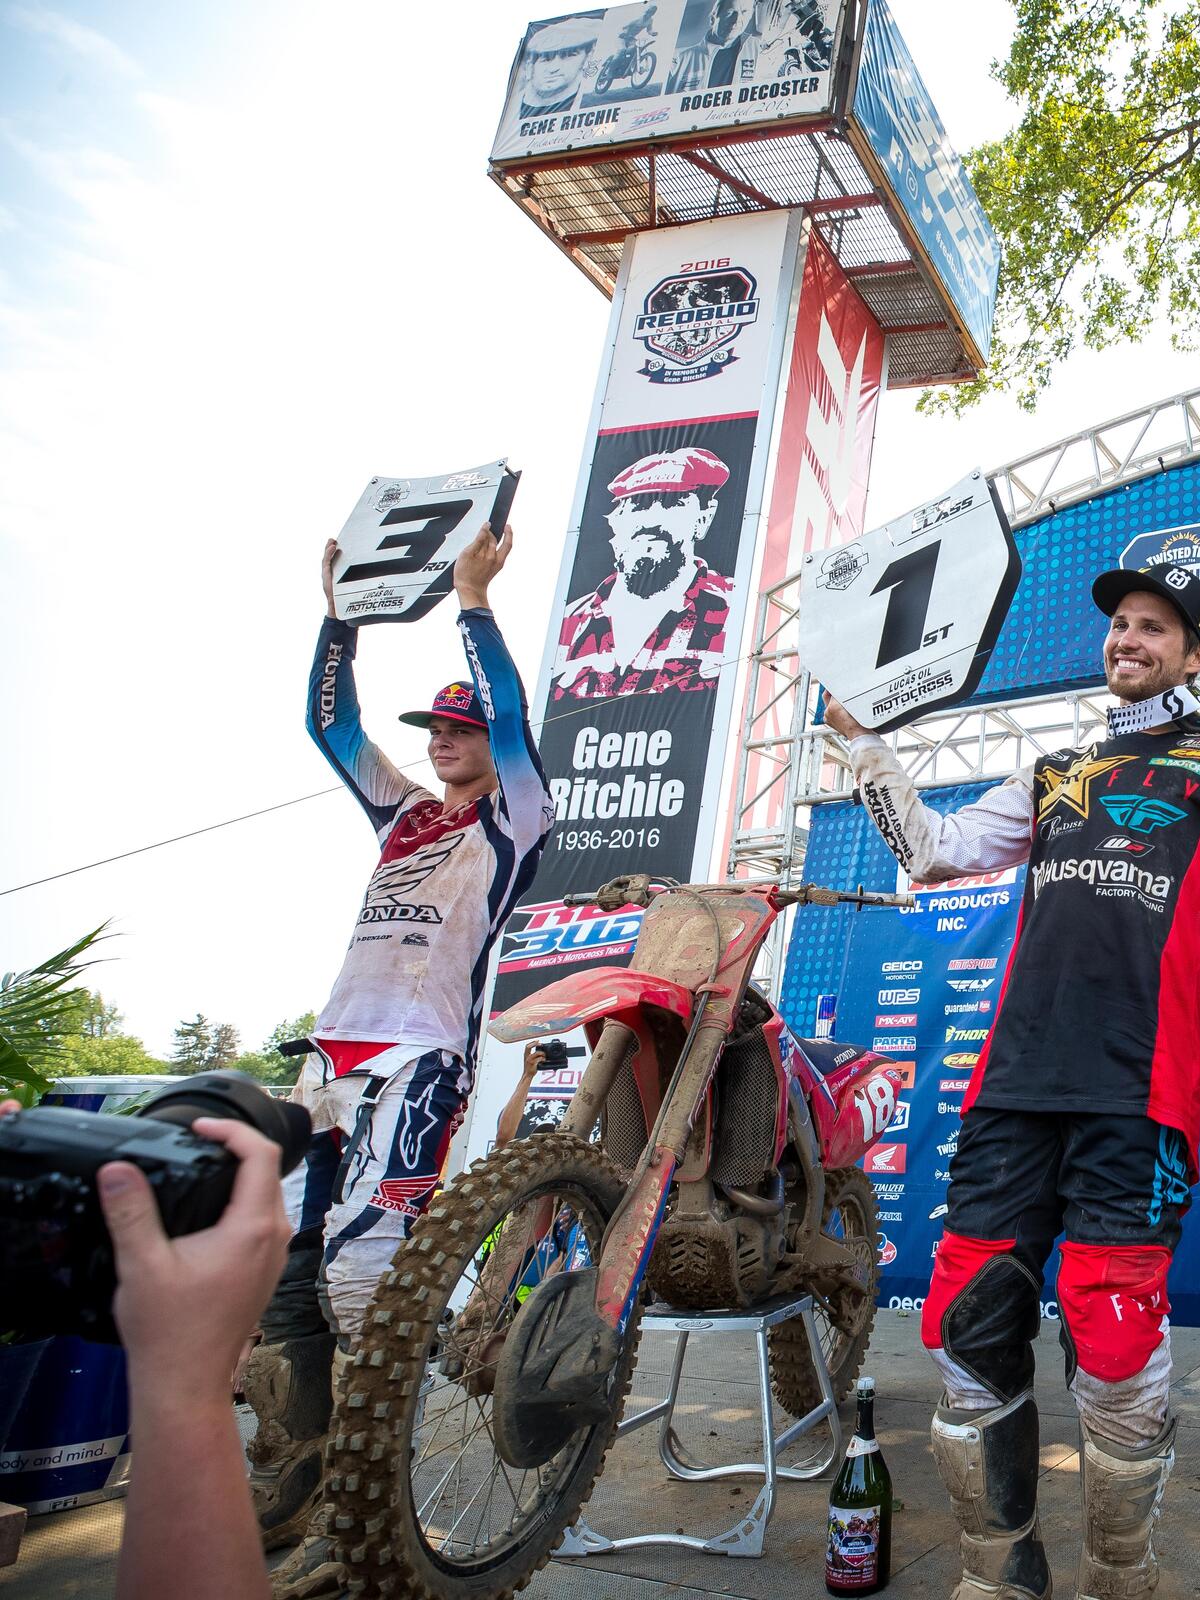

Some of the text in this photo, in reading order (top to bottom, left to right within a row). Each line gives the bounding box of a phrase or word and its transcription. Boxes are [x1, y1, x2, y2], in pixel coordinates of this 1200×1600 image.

[680, 77, 820, 112] ROGER DECOSTER
[520, 107, 621, 137] GENE RITCHIE
[680, 258, 730, 274] 2016
[638, 302, 756, 331] REDBUD
[655, 318, 733, 334] NATIONAL
[1146, 547, 1192, 566] TWISTED
[363, 588, 395, 600] LUCAS OIL
[345, 599, 404, 613] MOTOCROSS
[321, 641, 344, 732] HONDA
[888, 668, 932, 693] LUCAS OIL
[448, 697, 471, 710] Bull
[872, 674, 953, 716] MOTOCROSS
[571, 726, 673, 768] Gene
[549, 773, 687, 822] Ritchie
[879, 783, 914, 861] ENERGY DRINK
[554, 828, 661, 851] 1936-2016
[929, 891, 1010, 912] PRODUCTS
[1095, 888, 1164, 913] FACTORY RACING
[359, 905, 444, 925] ONDA
[936, 917, 967, 931] INC.
[881, 961, 923, 972] GEICO
[946, 978, 996, 990] FLY
[878, 989, 921, 1006] WPS
[944, 1001, 991, 1015] guaranteed Rate
[873, 1037, 916, 1047] PARTS
[952, 1029, 990, 1042] THOR
[833, 1047, 858, 1068] HONDA
[854, 1075, 896, 1144] 18
[368, 1195, 419, 1218] HONDA
[0, 1443, 107, 1472] ody and mind.
